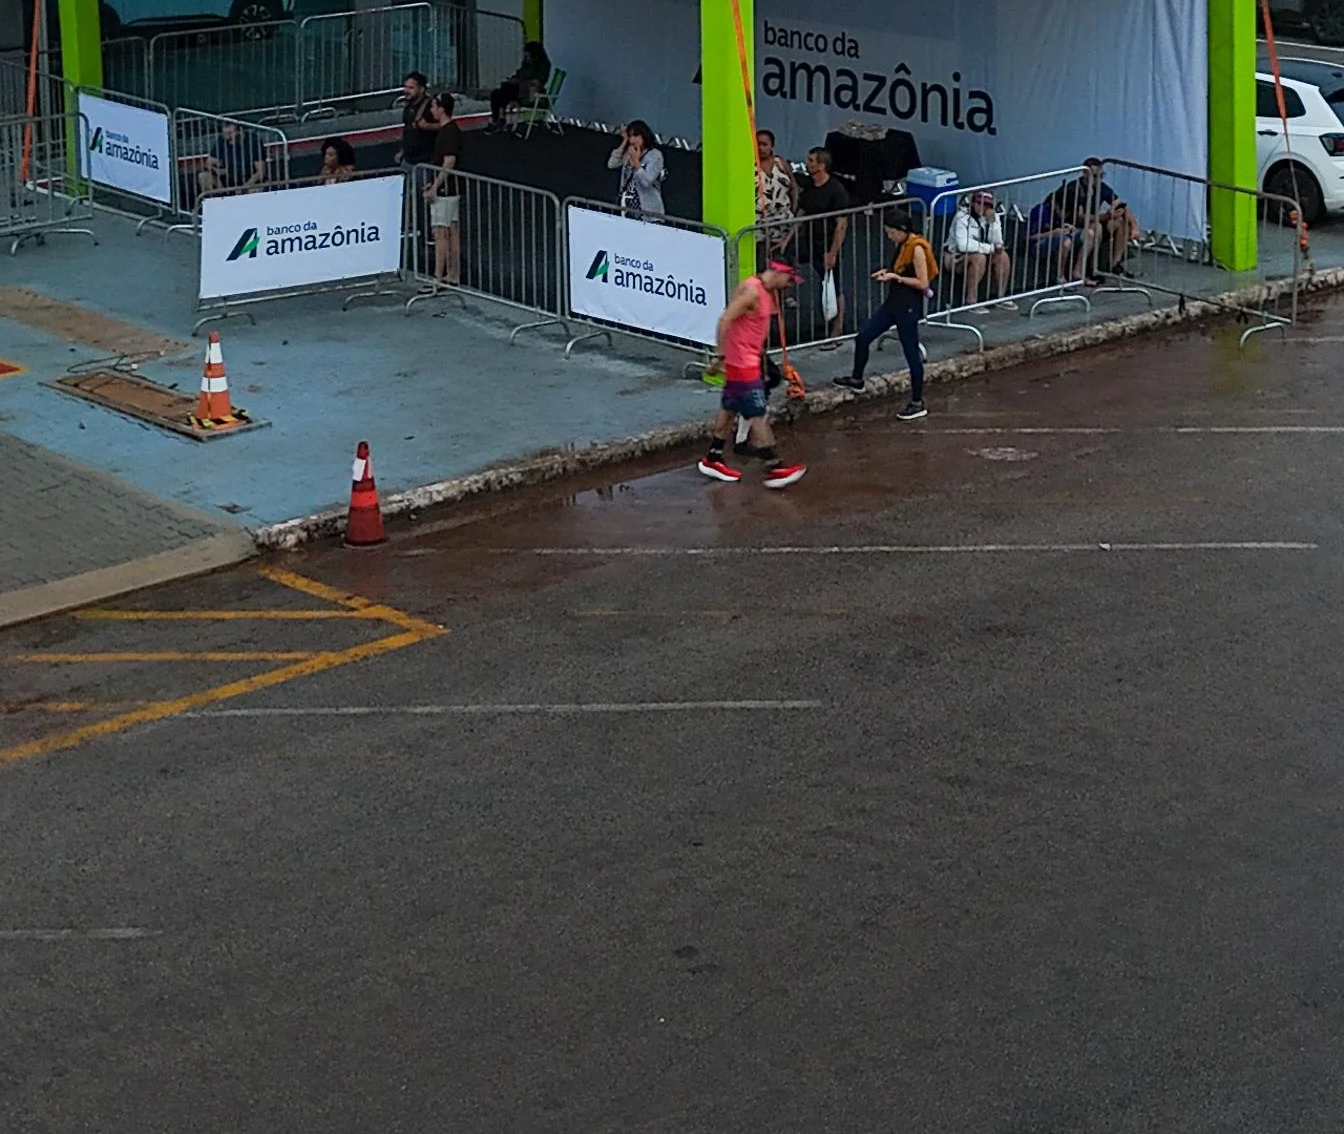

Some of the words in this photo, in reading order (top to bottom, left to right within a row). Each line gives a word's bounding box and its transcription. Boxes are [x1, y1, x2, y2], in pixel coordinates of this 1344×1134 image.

[763, 20, 829, 54] banco
[831, 30, 862, 60] da
[761, 56, 997, 136] amazônia
[105, 141, 160, 170] amazônia
[265, 221, 381, 256] amazônia
[266, 224, 301, 236] banco
[303, 221, 318, 233] da
[614, 253, 641, 269] banco
[642, 259, 654, 272] da
[613, 268, 708, 306] amazônia
